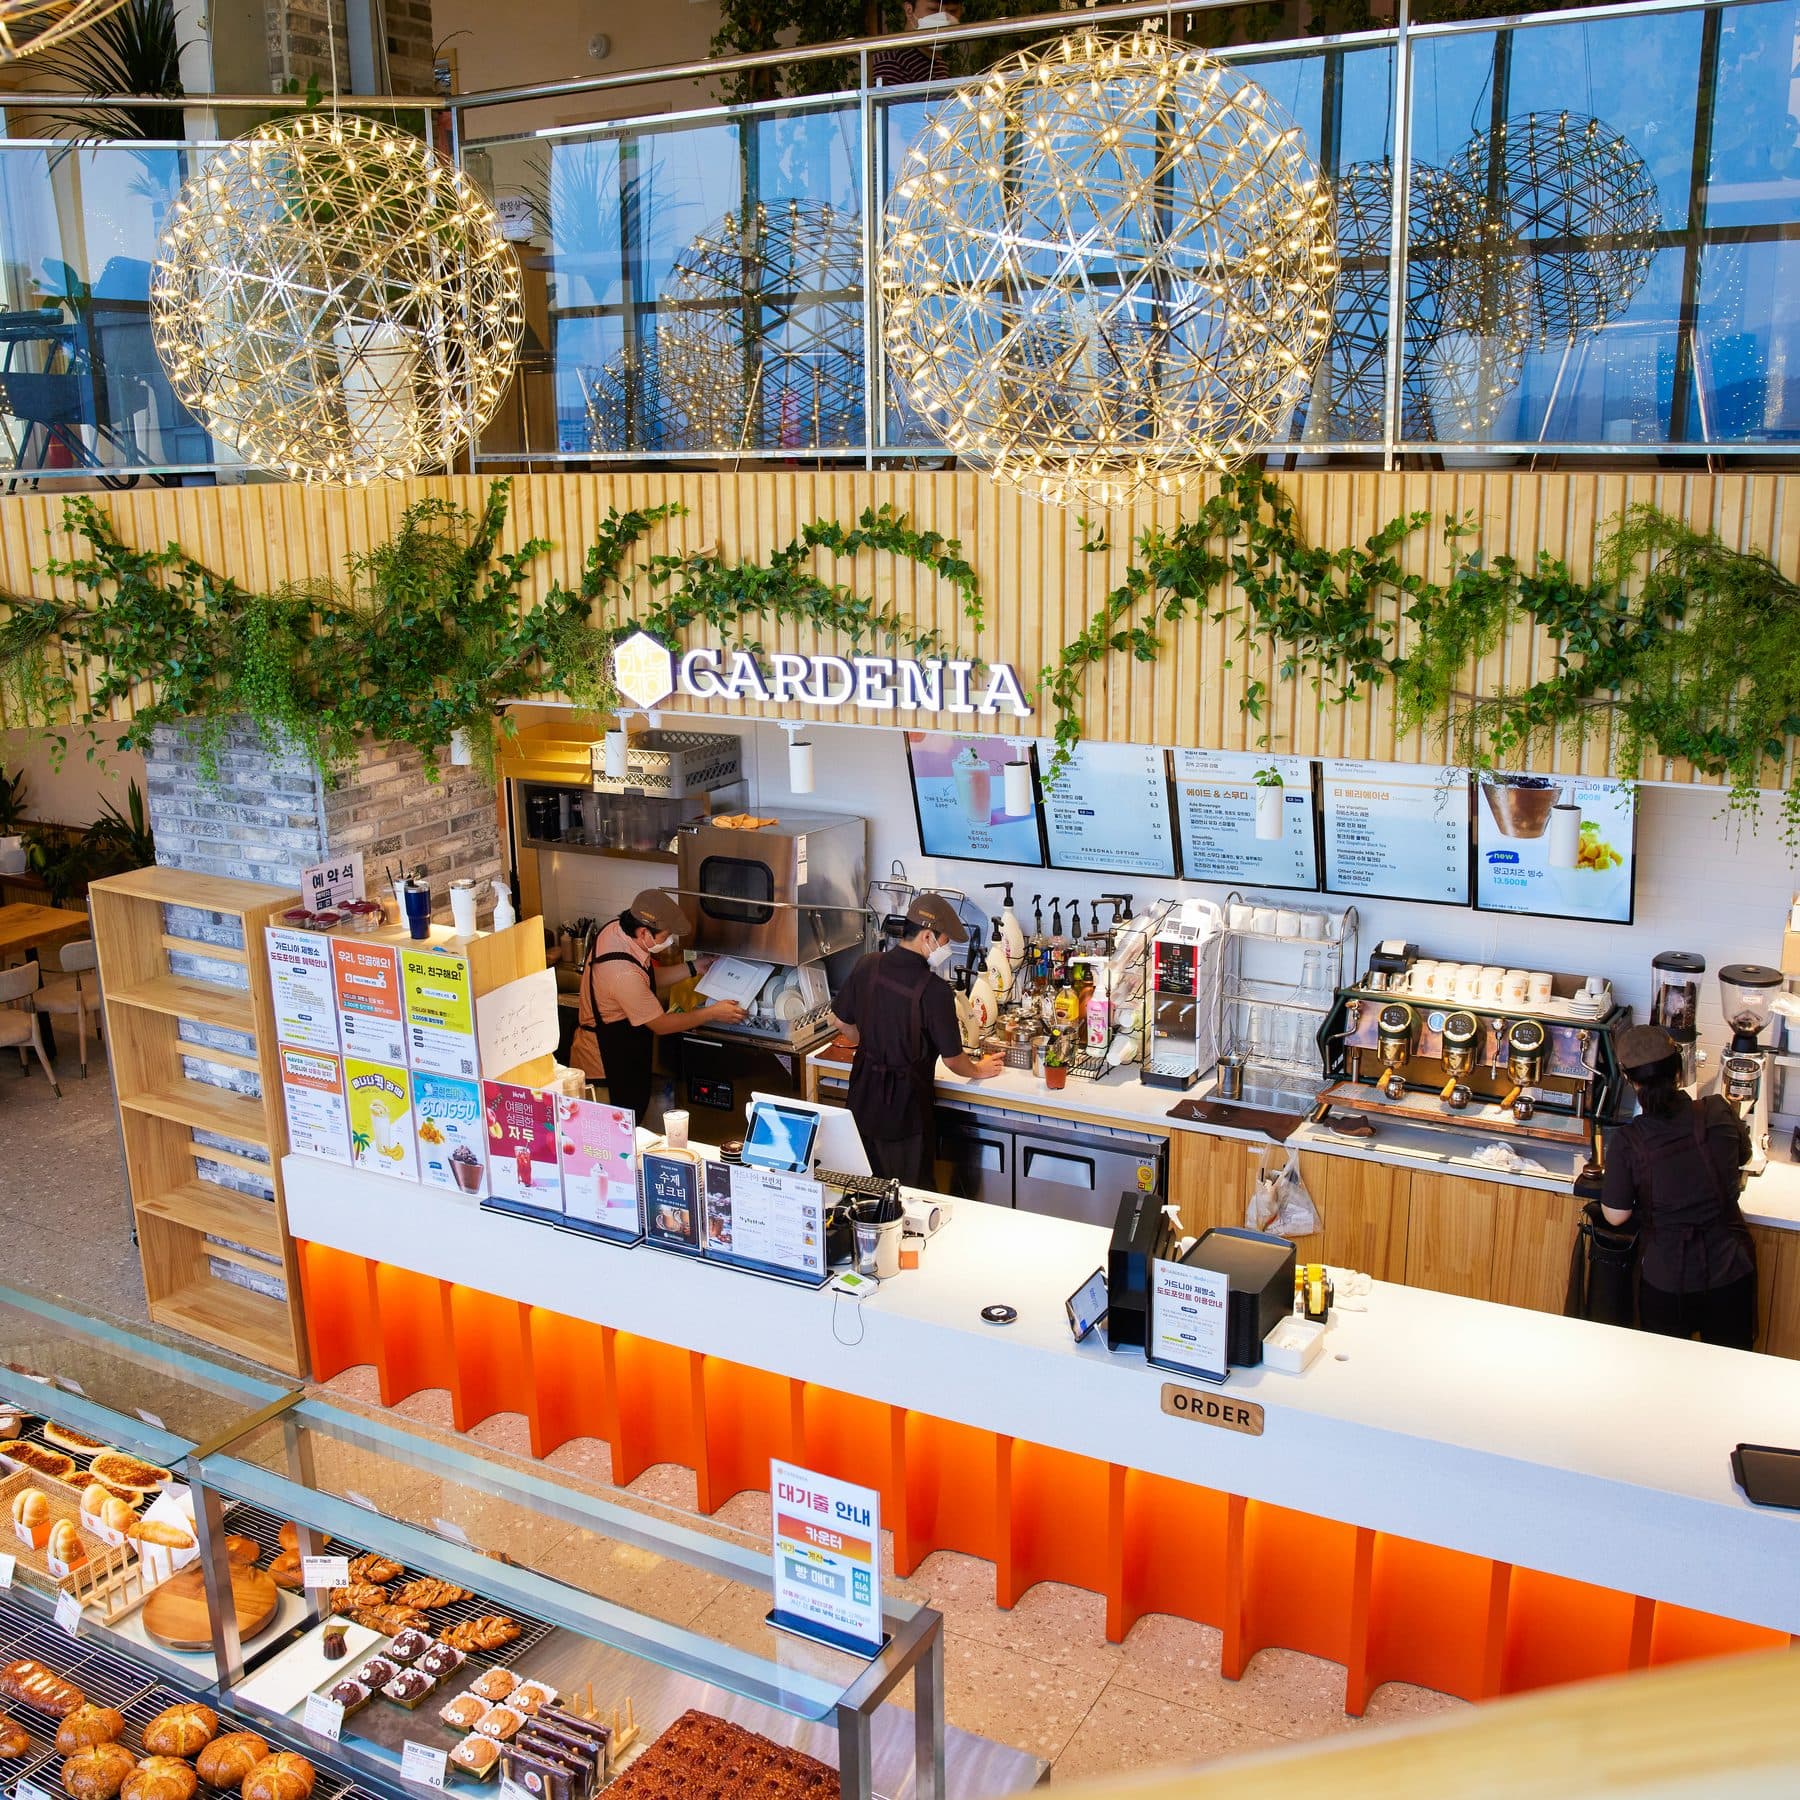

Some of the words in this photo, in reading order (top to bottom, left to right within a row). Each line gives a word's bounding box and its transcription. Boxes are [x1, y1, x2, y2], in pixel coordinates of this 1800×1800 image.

[681, 648, 1033, 716] GARDENIA
[1186, 788, 1212, 798] 에이드
[1223, 790, 1249, 800] 스무디
[1334, 789, 1342, 797] 티
[1345, 789, 1390, 801] 베리에이션
[1081, 847, 1113, 855] PERSONAL
[1493, 866, 1526, 877] 망고치즈
[1528, 869, 1544, 878] 빙수
[275, 942, 300, 953] 가드니아
[301, 946, 321, 956] 제빵소
[271, 952, 301, 964] 도도포인트
[338, 951, 356, 964] 우리,
[408, 963, 426, 975] 우리,
[428, 966, 462, 981] 친구해요!
[351, 1074, 384, 1090] 바나나킥
[386, 1080, 404, 1099] 라떼
[421, 1100, 477, 1121] BINGSU
[505, 1101, 533, 1116] 여름엔
[508, 1125, 535, 1143] 자두
[660, 1171, 680, 1187] 수제
[761, 1175, 782, 1187] 브런치
[654, 1183, 686, 1201] 밀크티
[1164, 1278, 1193, 1293] 가드니아
[1194, 1283, 1216, 1297] 제빵소
[1157, 1287, 1192, 1301] 도도포인트
[1193, 1295, 1223, 1309] 이용안내
[1173, 1394, 1251, 1427] ORDER
[778, 1482, 829, 1514] 대기줄
[835, 1501, 870, 1527] 안내
[805, 1525, 842, 1550] 카운터
[808, 1550, 823, 1564] 계산
[795, 1564, 808, 1579] 빵
[811, 1569, 835, 1589] 매대
[327, 1728, 338, 1739] 4.0
[428, 1776, 442, 1787] 4.0
